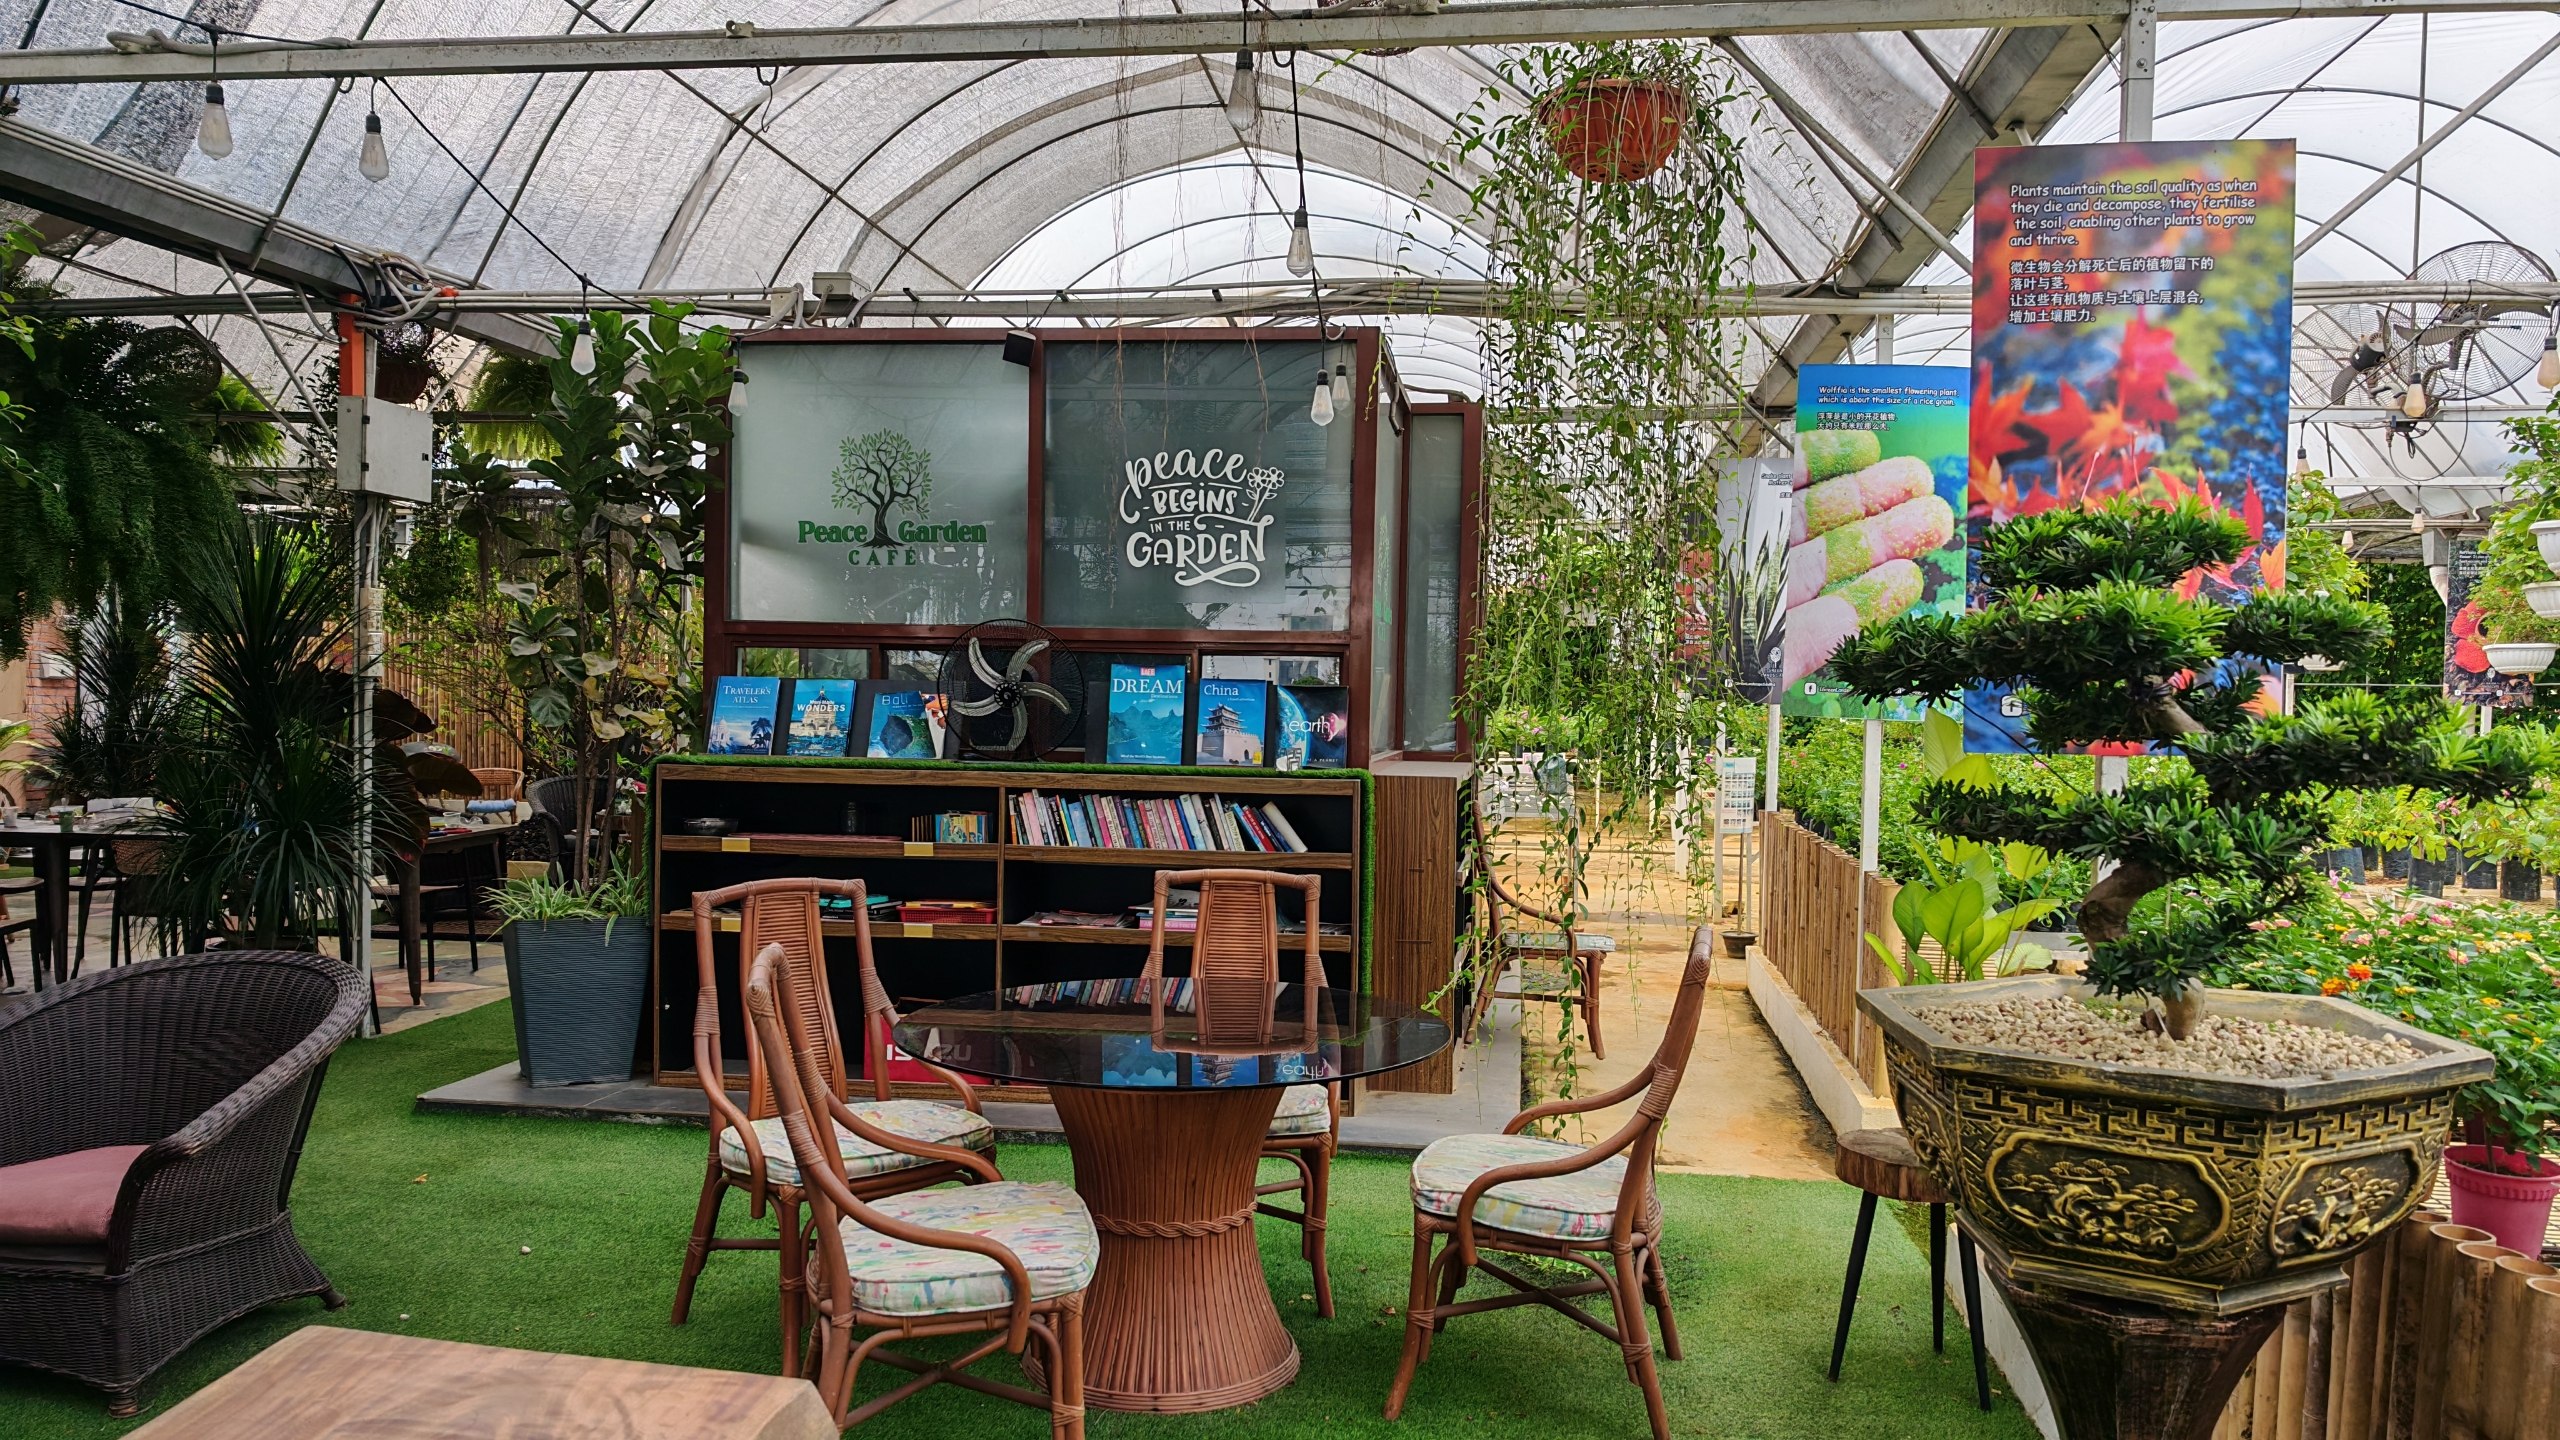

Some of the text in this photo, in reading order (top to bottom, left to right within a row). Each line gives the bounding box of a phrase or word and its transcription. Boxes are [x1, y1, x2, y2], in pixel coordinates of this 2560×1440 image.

[2010, 178, 2257, 197] Plants maintain the soil quality as when
[2010, 196, 2256, 216] they die and decompose, they fertilise
[2014, 213, 2256, 231] the soil, enabling other plants to grow
[2009, 233, 2079, 247] and thrive.
[2010, 256, 2214, 275] 微生物会分解死亡后的植物留下的
[2009, 308, 2097, 324] 增加土壤肥力。
[1818, 386, 1848, 394] Wolffia
[1849, 386, 1856, 394] is
[1858, 386, 1870, 394] the
[1872, 386, 1902, 395] smallest
[1904, 387, 1938, 397] flowering
[1872, 396, 1885, 404] the
[1903, 397, 1911, 405] of
[1919, 397, 1934, 405] rice
[798, 519, 988, 543] Peace Garden
[1150, 520, 1191, 534] IN THE
[1126, 517, 1274, 572] GARDEN
[847, 546, 917, 566] CAFÉ
[1112, 678, 1183, 694] DREAM
[1203, 684, 1239, 696] China
[732, 695, 759, 703] ATLAS
[881, 693, 908, 706] Bali
[797, 703, 846, 712] WONDERS
[1289, 715, 1330, 733] earth
